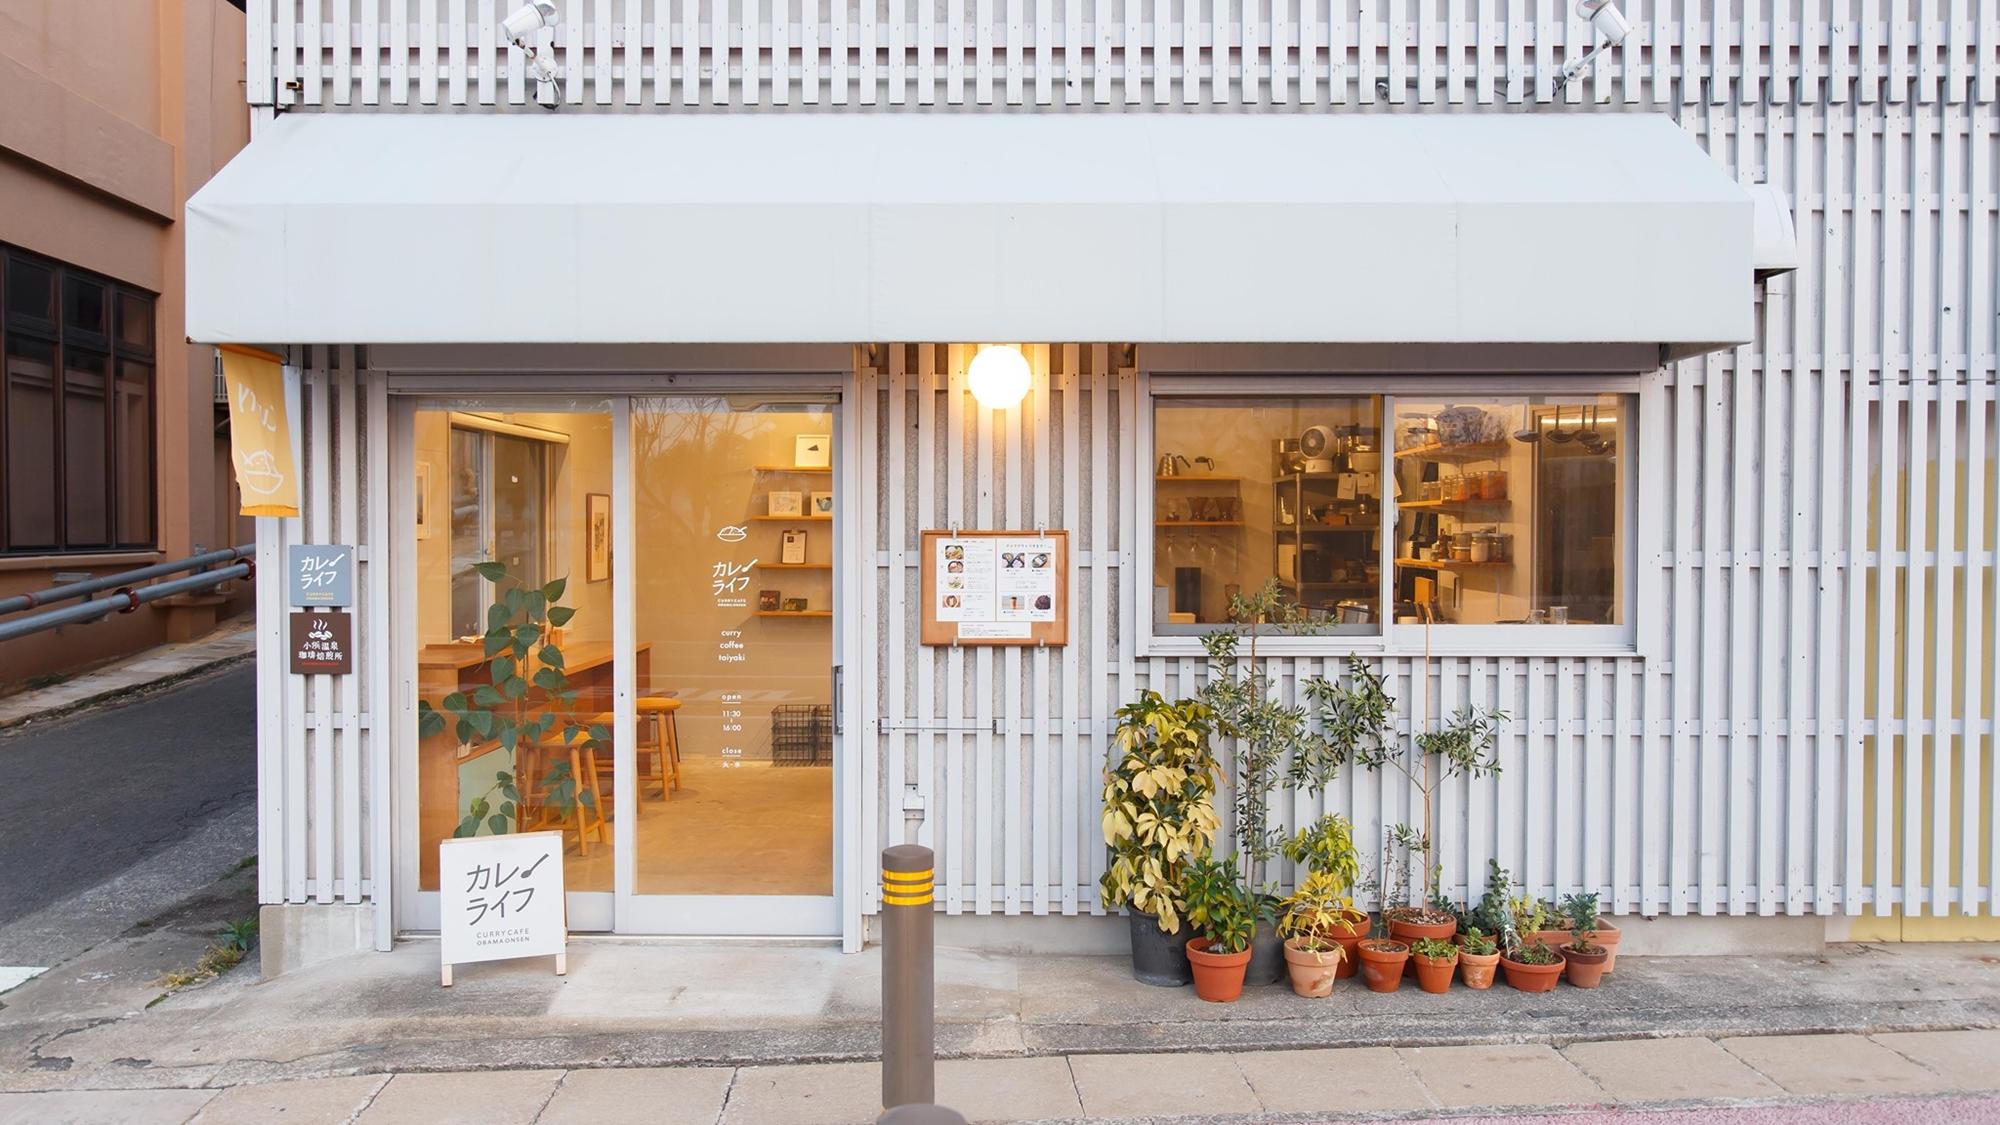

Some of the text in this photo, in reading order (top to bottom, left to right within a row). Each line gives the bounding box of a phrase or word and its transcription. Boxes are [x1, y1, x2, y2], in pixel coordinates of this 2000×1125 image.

[301, 571, 337, 590] ライフ
[712, 576, 750, 596] ライフ
[720, 630, 742, 638] curry
[719, 640, 744, 649] coffee
[718, 654, 745, 663] taiyaki
[721, 746, 742, 754] close
[466, 888, 535, 926] ライフ
